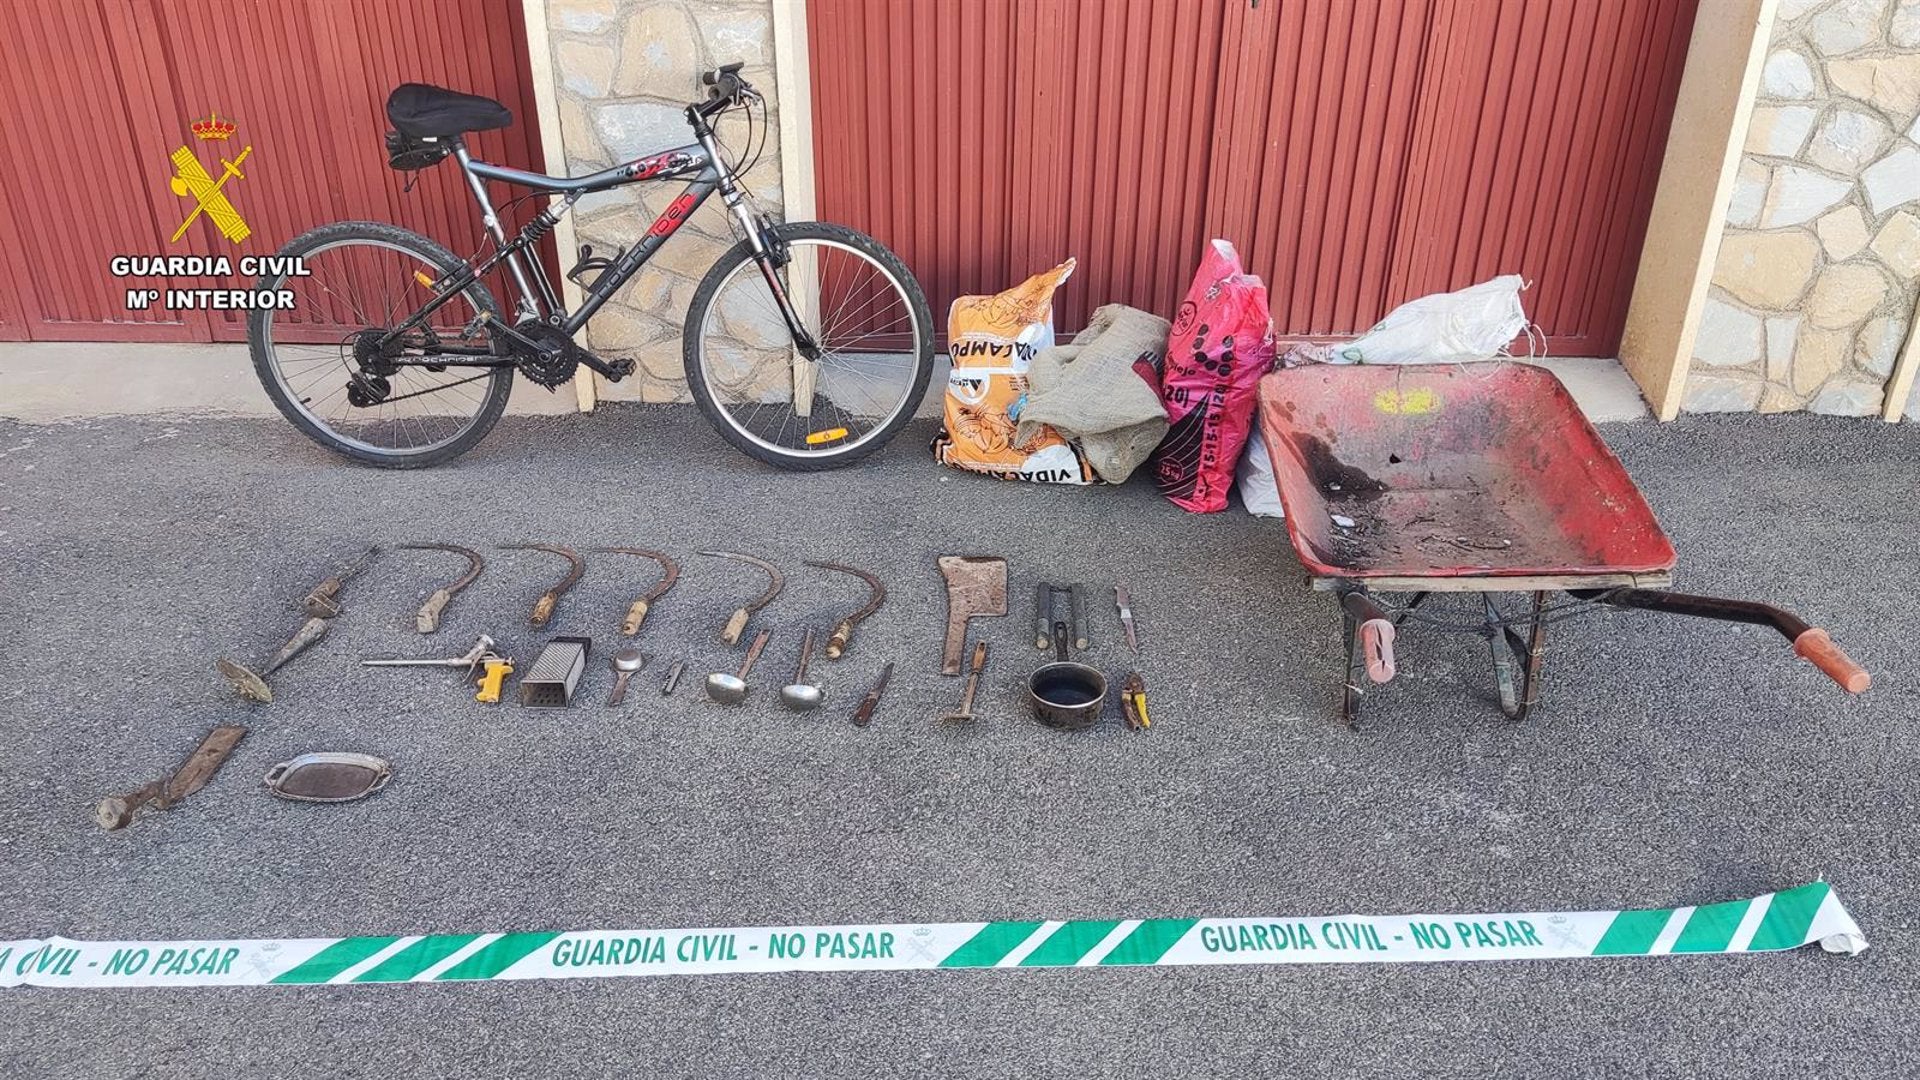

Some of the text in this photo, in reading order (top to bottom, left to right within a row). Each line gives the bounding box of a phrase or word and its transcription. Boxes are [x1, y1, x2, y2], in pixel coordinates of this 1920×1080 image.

[552, 936, 666, 966] GUARDIA
[676, 934, 737, 963] CIVIL
[768, 932, 807, 960] NO
[814, 931, 895, 959] PASAR
[1200, 921, 1315, 953] GUARDIA
[1321, 920, 1388, 952] CIVIL
[1409, 921, 1452, 951] NO
[1458, 919, 1543, 949] PASAR
[102, 948, 150, 975] NO
[149, 947, 240, 975] PASAR
